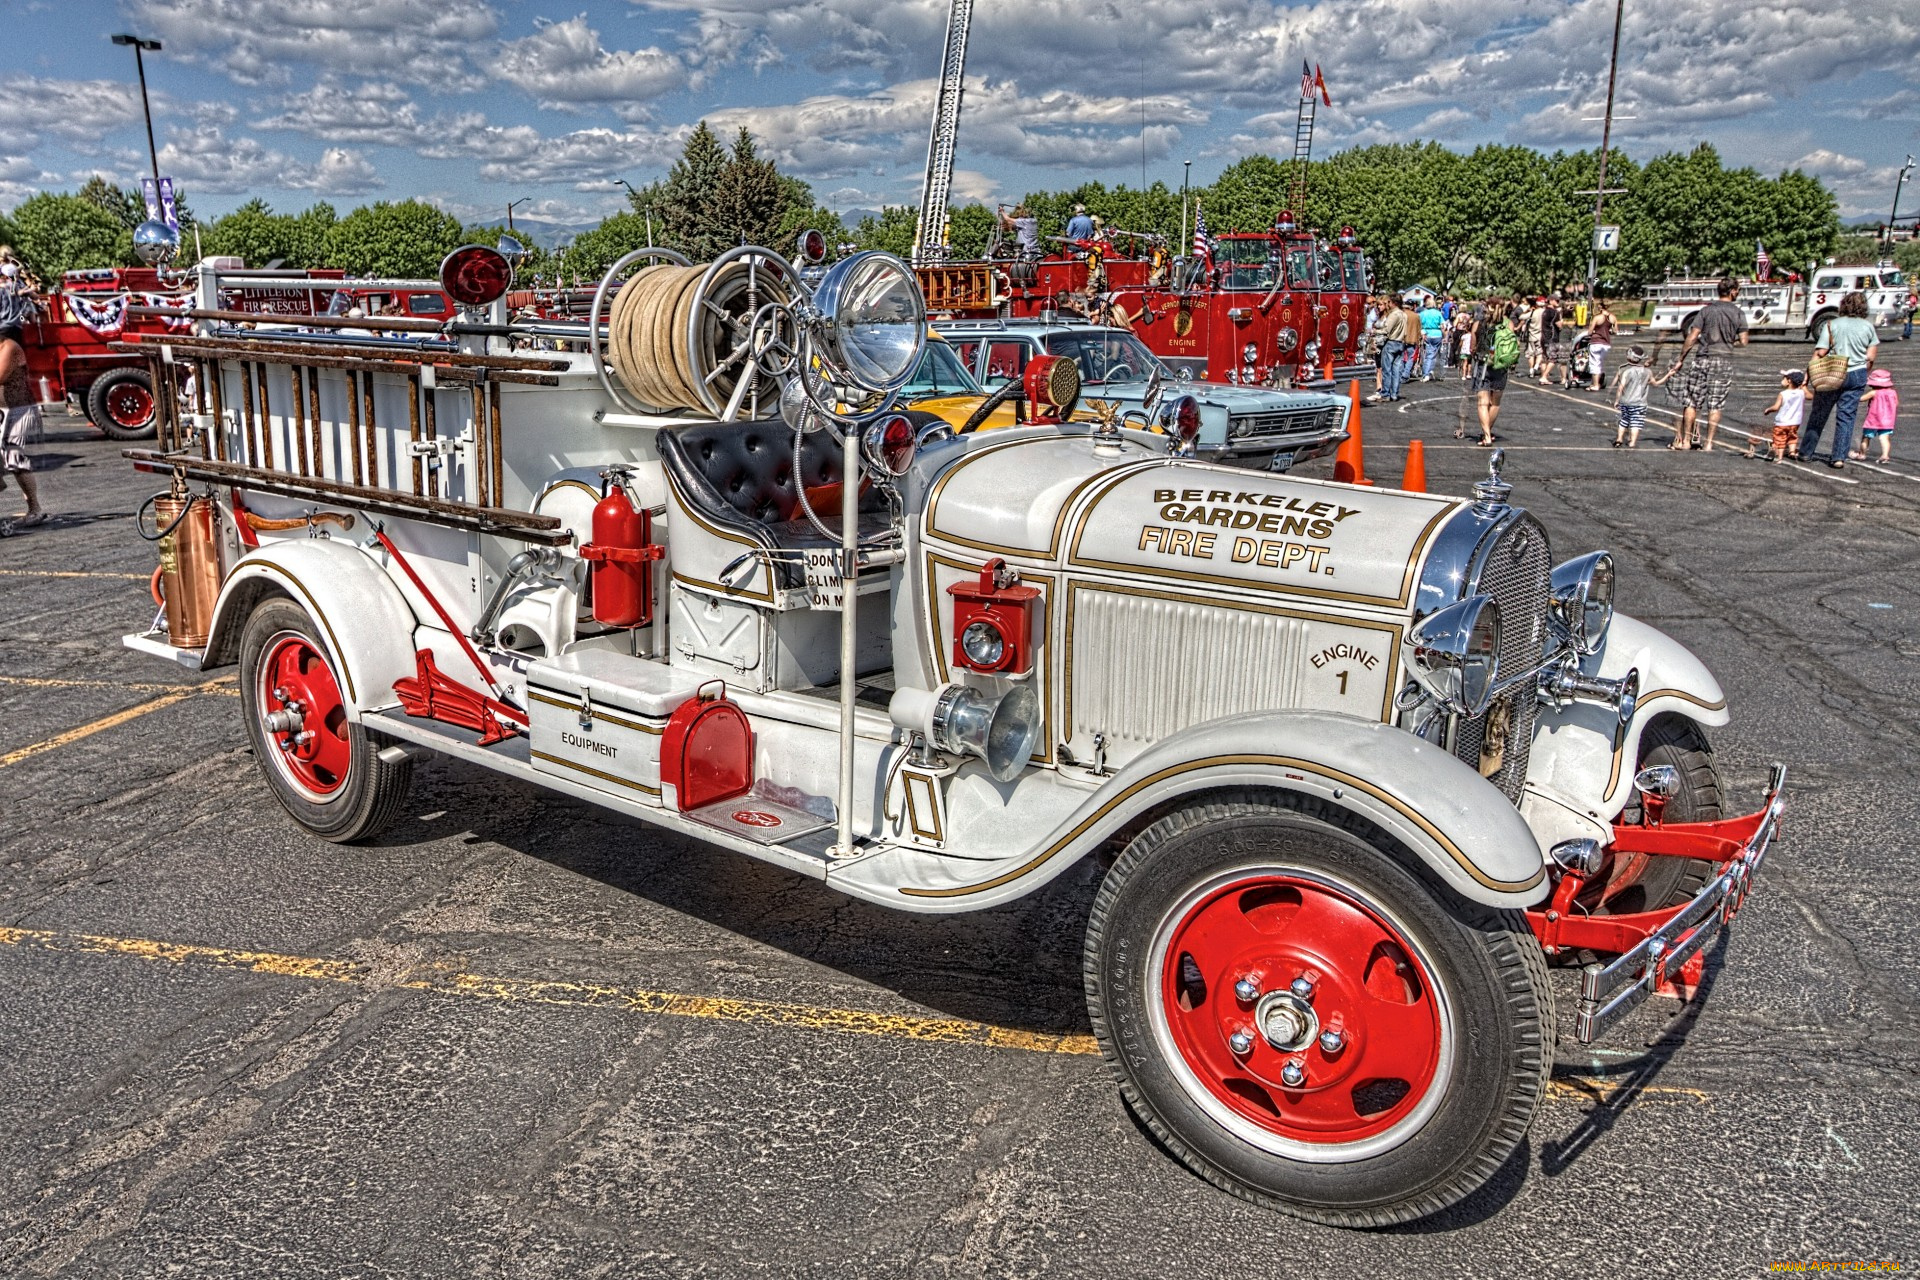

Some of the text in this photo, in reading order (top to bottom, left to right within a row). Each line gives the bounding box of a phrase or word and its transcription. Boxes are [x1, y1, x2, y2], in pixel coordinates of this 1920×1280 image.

[244, 288, 303, 299] LITTLETON
[270, 301, 308, 311] RESCUE
[1816, 294, 1826, 304] 3
[1154, 489, 1361, 522] BERKELEY
[1160, 503, 1335, 539] GARDENS
[1138, 525, 1335, 575] FIRE DEPT.
[807, 575, 843, 588] CLIM
[814, 594, 829, 606] ON
[1310, 644, 1379, 671] ENGINE
[1336, 670, 1348, 695] 1
[561, 732, 618, 758] EQUIPMENT
